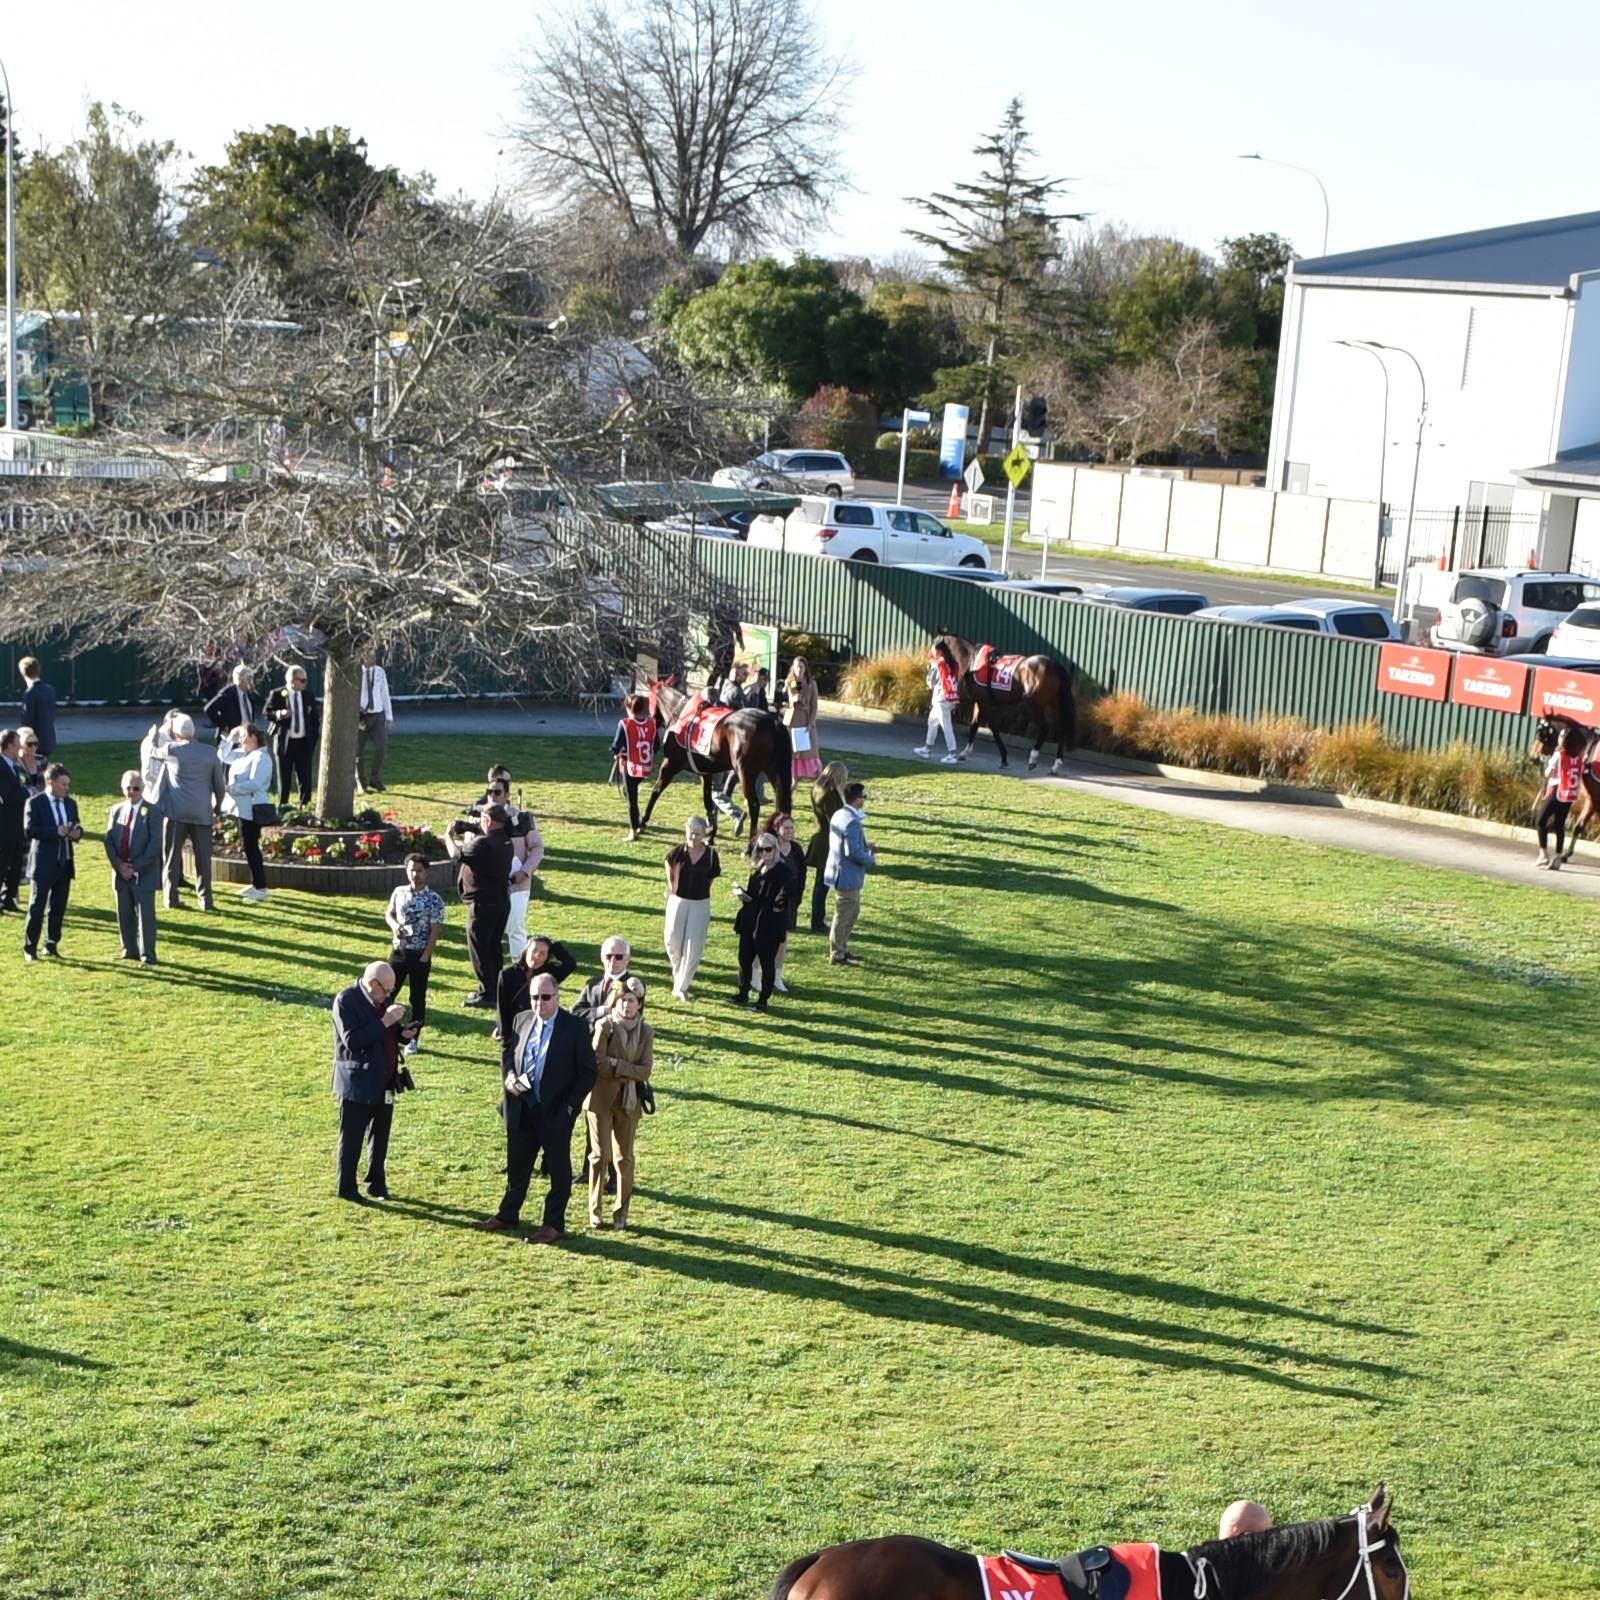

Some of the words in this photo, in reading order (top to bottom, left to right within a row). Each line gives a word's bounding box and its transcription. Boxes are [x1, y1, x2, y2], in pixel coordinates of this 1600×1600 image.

[1388, 666, 1435, 687] TARZINO
[1463, 678, 1512, 698] TARZINO
[1542, 691, 1594, 713] TARZINO
